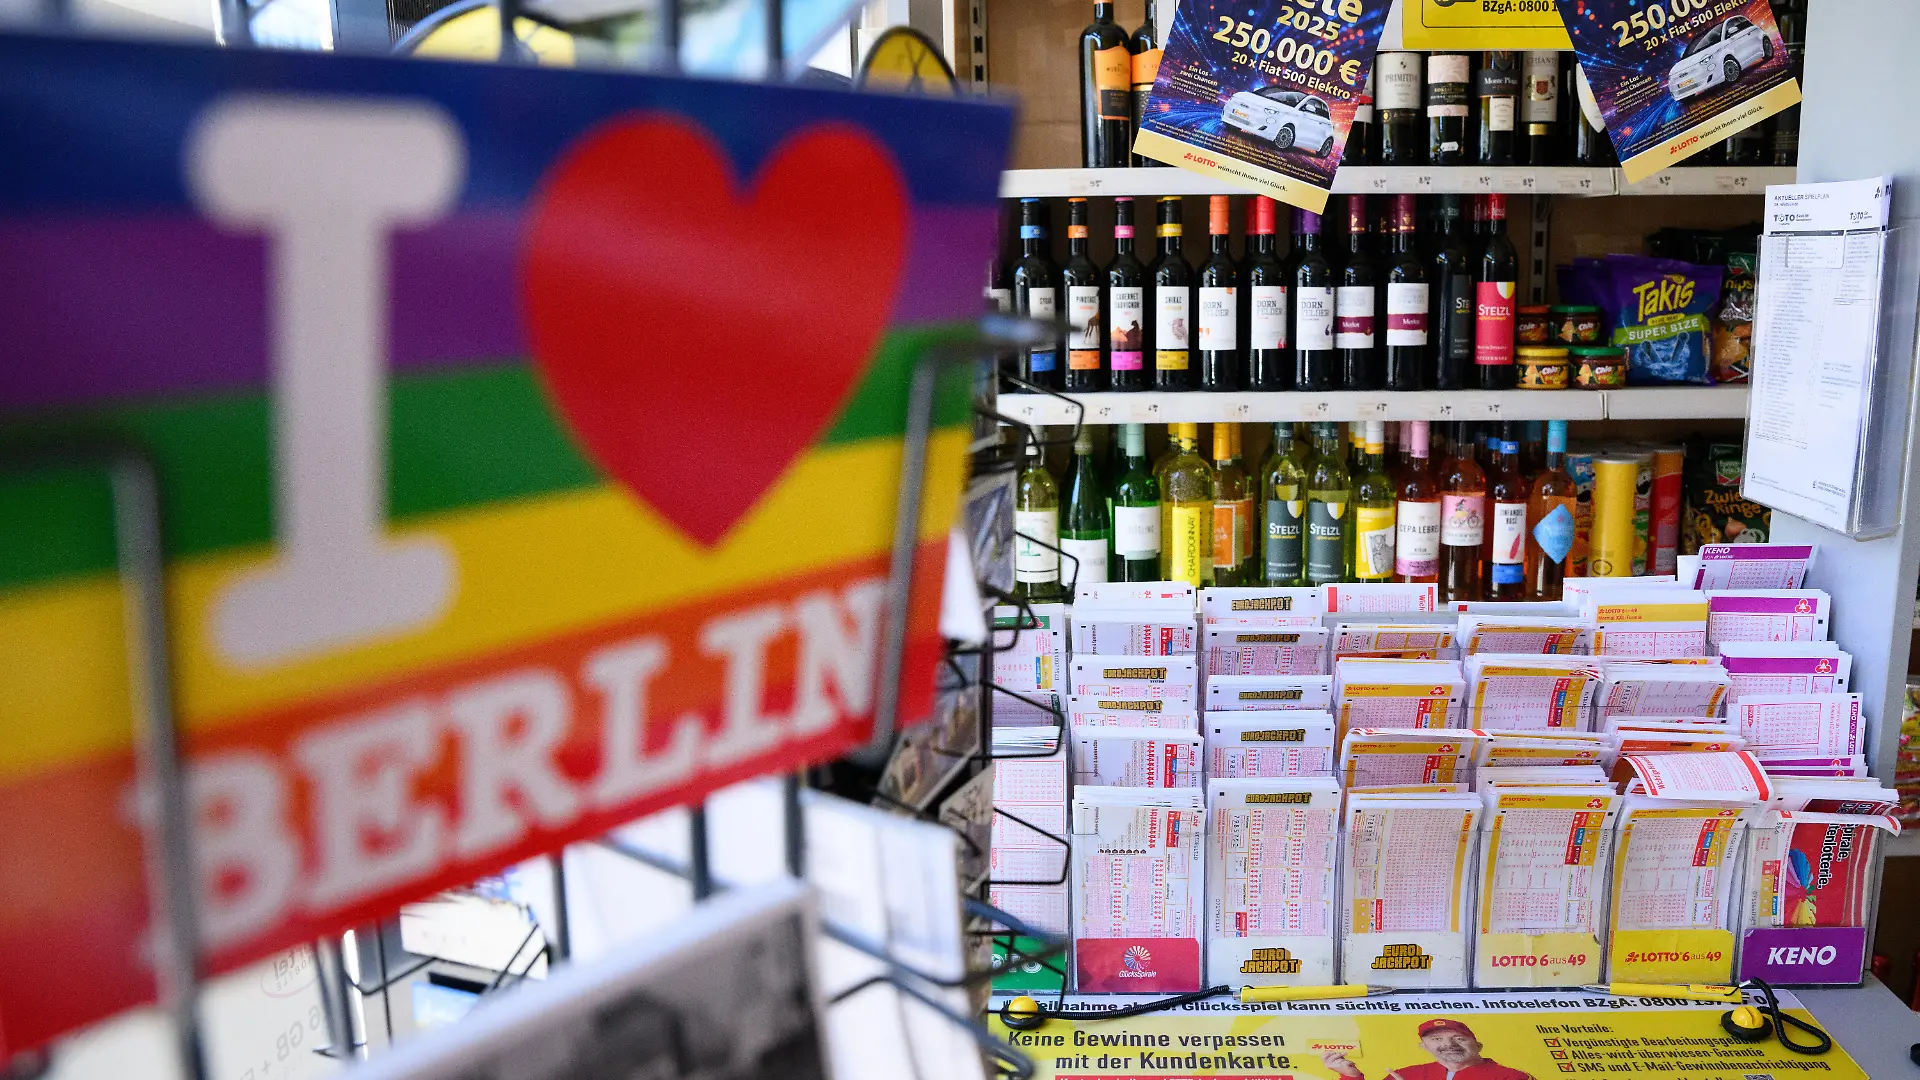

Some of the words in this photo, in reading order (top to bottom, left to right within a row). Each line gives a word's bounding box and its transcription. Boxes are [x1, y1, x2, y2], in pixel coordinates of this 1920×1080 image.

[1482, 0, 1516, 14] BZgA:
[1519, 0, 1549, 12] 0800
[1276, 5, 1341, 41] 2025
[1644, 36, 1659, 51] 20
[1661, 34, 1669, 44] x
[1668, 24, 1692, 39] Fiat
[1692, 10, 1714, 28] 500
[1212, 15, 1334, 76] 250.000
[1339, 59, 1362, 86] €
[1193, 74, 1218, 87] Chancen
[1231, 51, 1248, 65] 20
[1248, 58, 1258, 69] x
[1258, 60, 1282, 77] Fiat
[1282, 69, 1306, 85] 500
[1307, 78, 1351, 100] Elektro
[1677, 135, 1699, 151] LOTTO
[1699, 124, 1722, 140] wünscht
[1721, 118, 1737, 130] Ihnen
[1737, 112, 1747, 122] viel
[1747, 105, 1765, 117] Glück.
[1193, 155, 1216, 168] LOTTO
[1217, 164, 1242, 178] wünscht
[1241, 171, 1258, 183] Ihnen
[1258, 176, 1269, 186] viel
[1269, 180, 1288, 192] Glück.
[1257, 300, 1277, 308] DORN
[1301, 301, 1323, 309] DORN
[1632, 274, 1696, 322] Takis
[1578, 322, 1594, 330] Chio
[1628, 325, 1667, 341] SUPER
[1670, 317, 1699, 333] SIZE
[1541, 366, 1558, 375] Chio
[1595, 365, 1613, 375] Chio
[181, 91, 468, 671] I
[1399, 524, 1417, 533] CEPA
[1187, 516, 1196, 577] CHARDONNAY
[1231, 596, 1292, 611] EUROJACKPOT
[1236, 633, 1301, 644] EUROJACKPOT
[1103, 667, 1168, 680] EUROJACKPOT
[1238, 689, 1303, 701] EUROJACKPOT
[1097, 700, 1164, 711] EUROJACKPOT
[1240, 728, 1306, 742] EUROJACKPOT
[118, 578, 899, 970] BERLIN
[1245, 791, 1312, 804] EUROJACKPOT
[1251, 948, 1292, 960] EURO
[1383, 944, 1422, 957] EURO
[1641, 952, 1679, 962] LOTTO
[1682, 951, 1690, 962] 6
[1706, 951, 1722, 962] 49
[1767, 945, 1838, 966] KENO
[1240, 959, 1302, 973] JACKPOT
[1371, 956, 1433, 970] JACKPOT
[1491, 955, 1538, 967] LOTTO
[1539, 954, 1549, 966] 6
[1549, 956, 1567, 964] aus
[1567, 953, 1586, 966] 49
[1185, 999, 1279, 1013] Glücksspiel
[1288, 1001, 1330, 1011] kann
[1336, 999, 1401, 1012] süchtig
[1405, 999, 1478, 1010] machen.
[1483, 998, 1581, 1009] Infotelefon
[1583, 997, 1638, 1009] BZgA:
[1640, 997, 1689, 1007] 0800
[1536, 1024, 1559, 1034] Ihre
[1560, 1023, 1614, 1034] Vorteile:
[1008, 1031, 1065, 1047] Keine
[1073, 1030, 1170, 1047] Gewinne
[1178, 1033, 1285, 1050] verpassen
[1563, 1037, 1639, 1049] Vergünstigte
[1055, 1053, 1089, 1069] mit
[1097, 1054, 1132, 1069] der
[1140, 1051, 1297, 1069] Kundenkarte.
[1572, 1048, 1764, 1060] Alles-wird-überwiesen-Garantie
[1577, 1062, 1604, 1073] SMS
[1608, 1061, 1631, 1072] und
[1634, 1059, 1831, 1072] E-Mail-Gewinnbenachrichtigung
